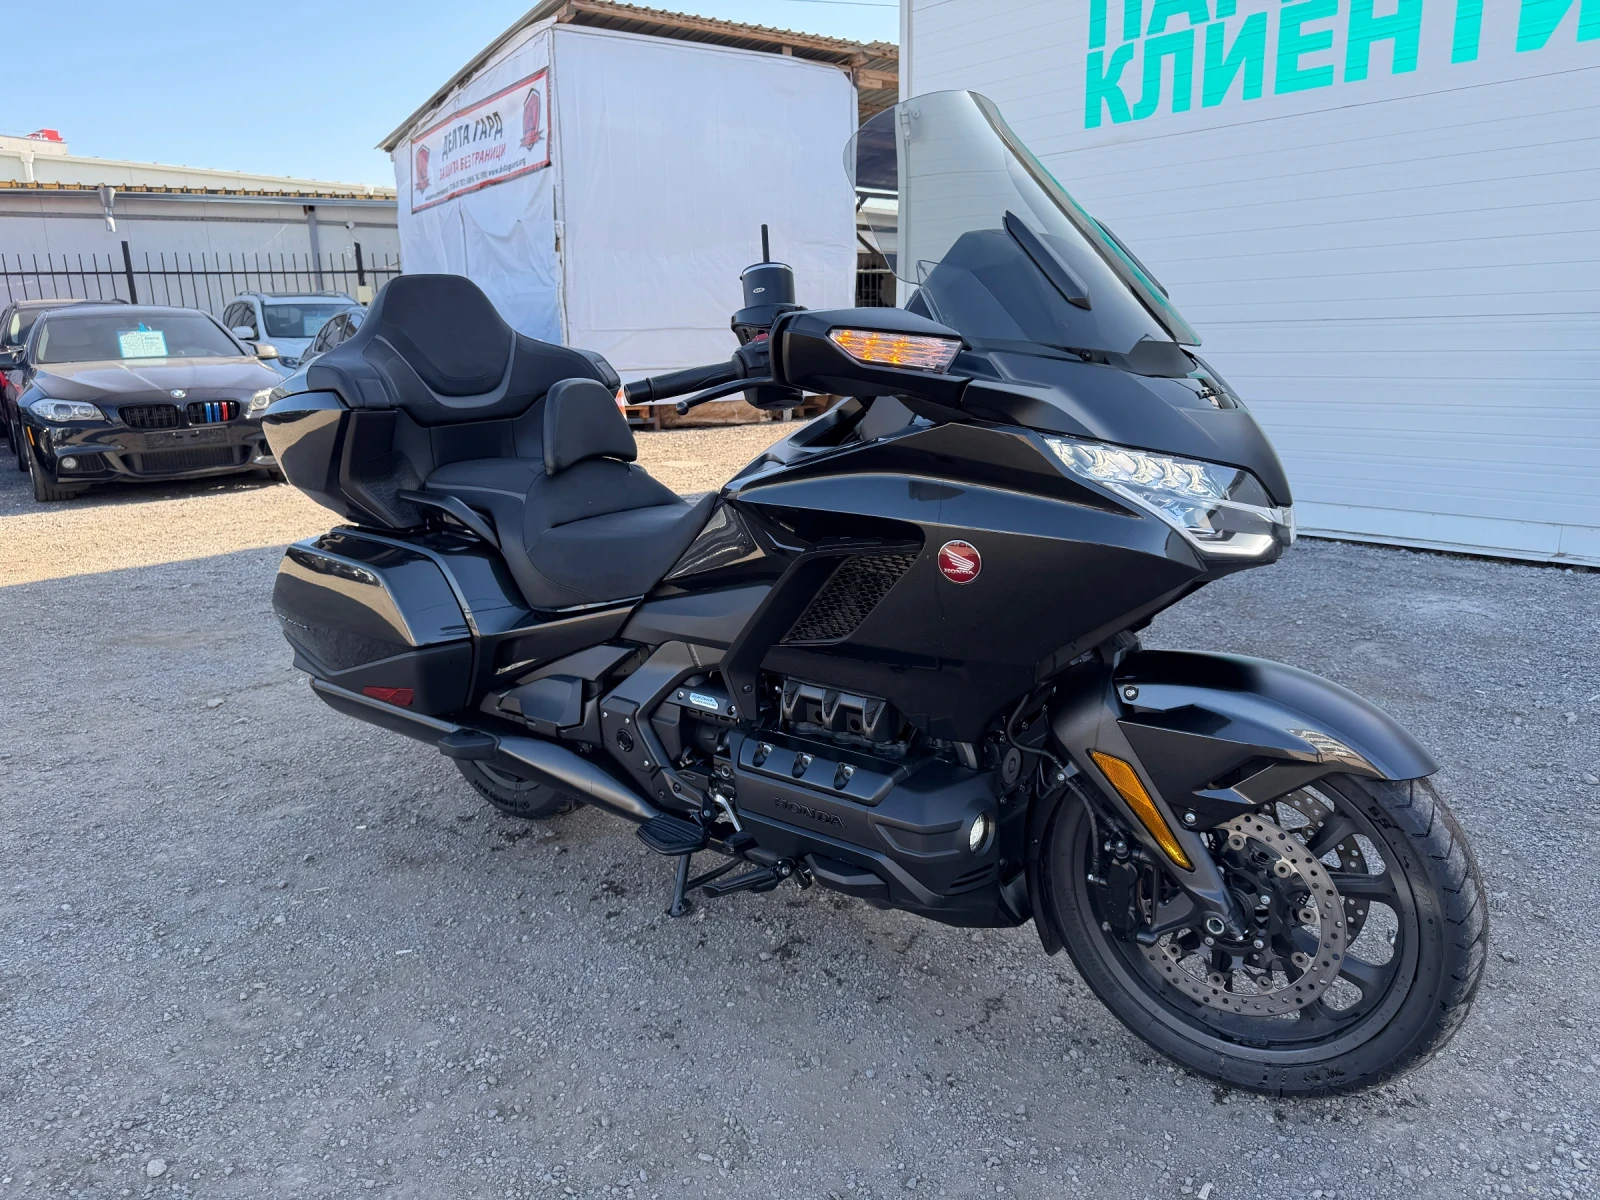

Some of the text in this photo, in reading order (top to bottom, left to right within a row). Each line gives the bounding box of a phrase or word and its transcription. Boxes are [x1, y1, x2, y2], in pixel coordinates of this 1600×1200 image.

[442, 111, 503, 161] ДЕЛТА ГАРД
[460, 154, 471, 171] БЕЗ
[472, 142, 506, 166] ГРАНИЦИ
[944, 567, 975, 575] HONDA
[772, 796, 848, 829] HONDA
